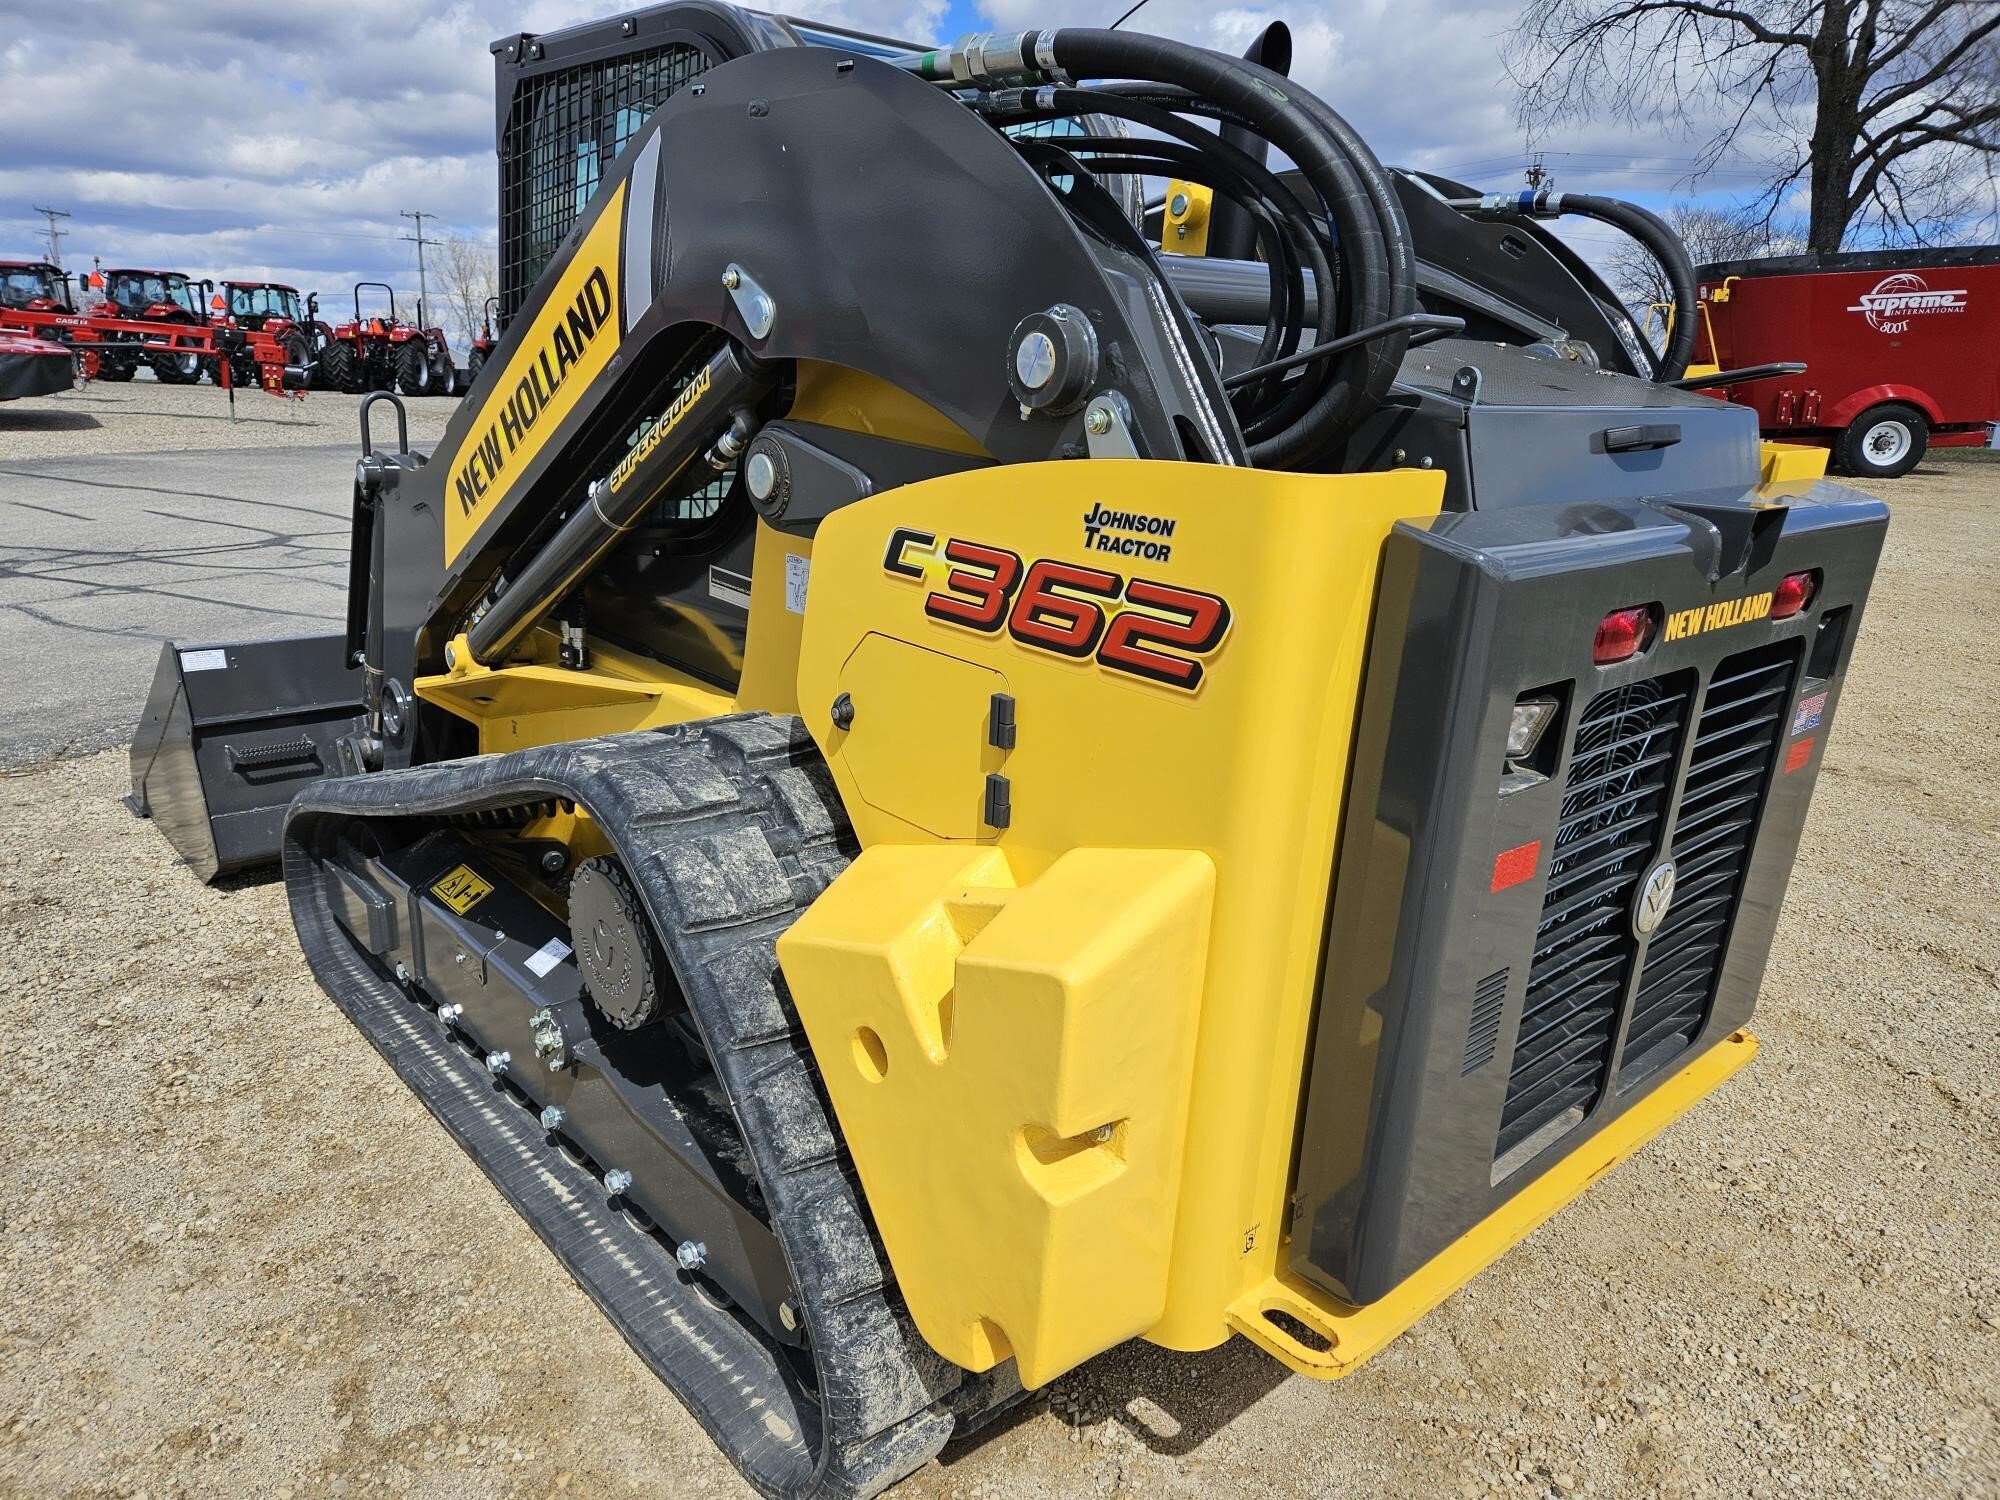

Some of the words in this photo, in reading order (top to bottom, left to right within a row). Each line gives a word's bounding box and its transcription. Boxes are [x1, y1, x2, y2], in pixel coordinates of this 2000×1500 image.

[1848, 290, 1967, 316] Supreme
[1890, 306, 1965, 316] INTERNATIONAL
[56, 317, 79, 325] CASE
[1880, 319, 1910, 334] 800T
[455, 424, 504, 517] NEW
[500, 266, 611, 455] HOLLAND
[610, 422, 659, 493] SUPER
[660, 365, 711, 438] BOOM
[1083, 502, 1176, 537] JOHNSON
[1084, 525, 1171, 562] TRACTOR
[1663, 606, 1706, 642] NEW
[1703, 591, 1773, 633] HOLLAND
